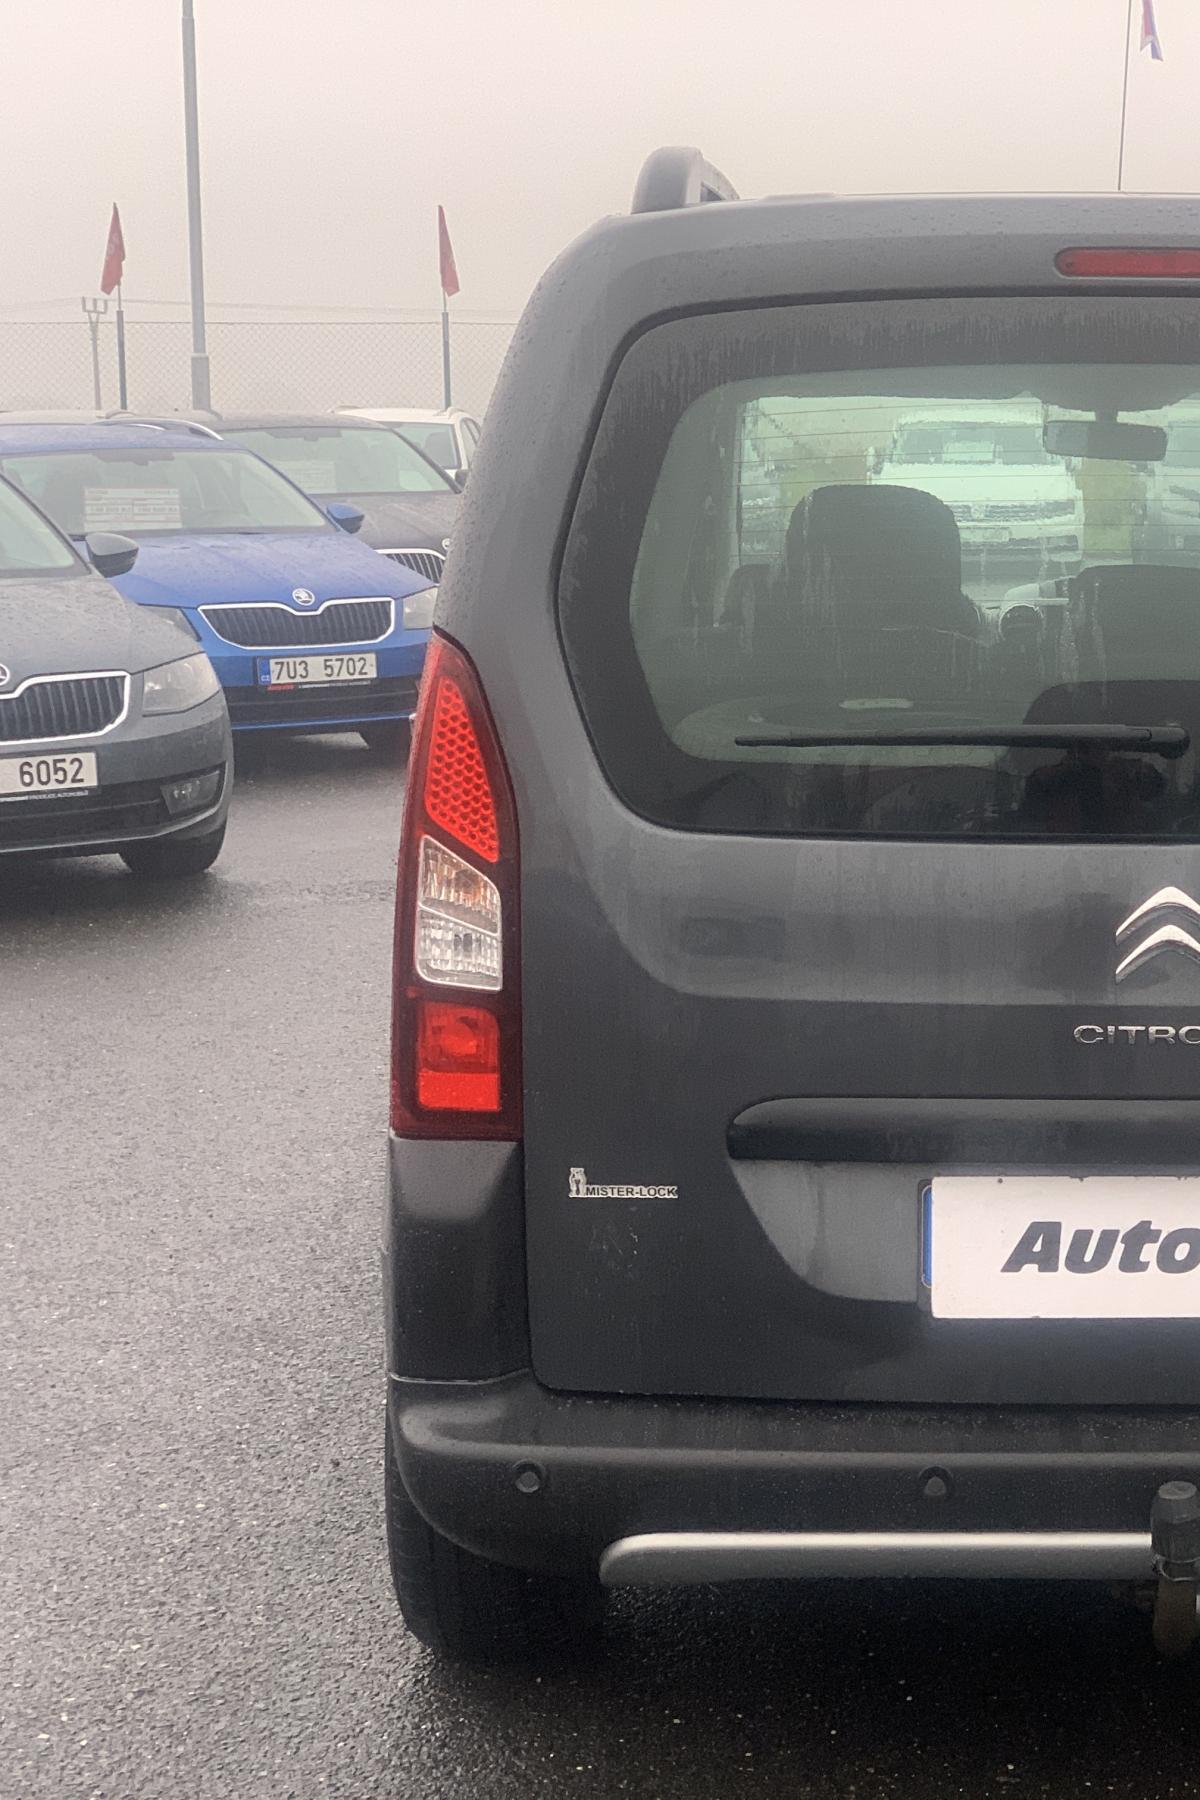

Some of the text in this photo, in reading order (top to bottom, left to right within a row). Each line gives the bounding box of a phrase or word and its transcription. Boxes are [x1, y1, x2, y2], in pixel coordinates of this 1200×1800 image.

[274, 657, 368, 681] 7U3 5702
[19, 757, 84, 787] 6052
[585, 1186, 677, 1197] MISTER-LOCK
